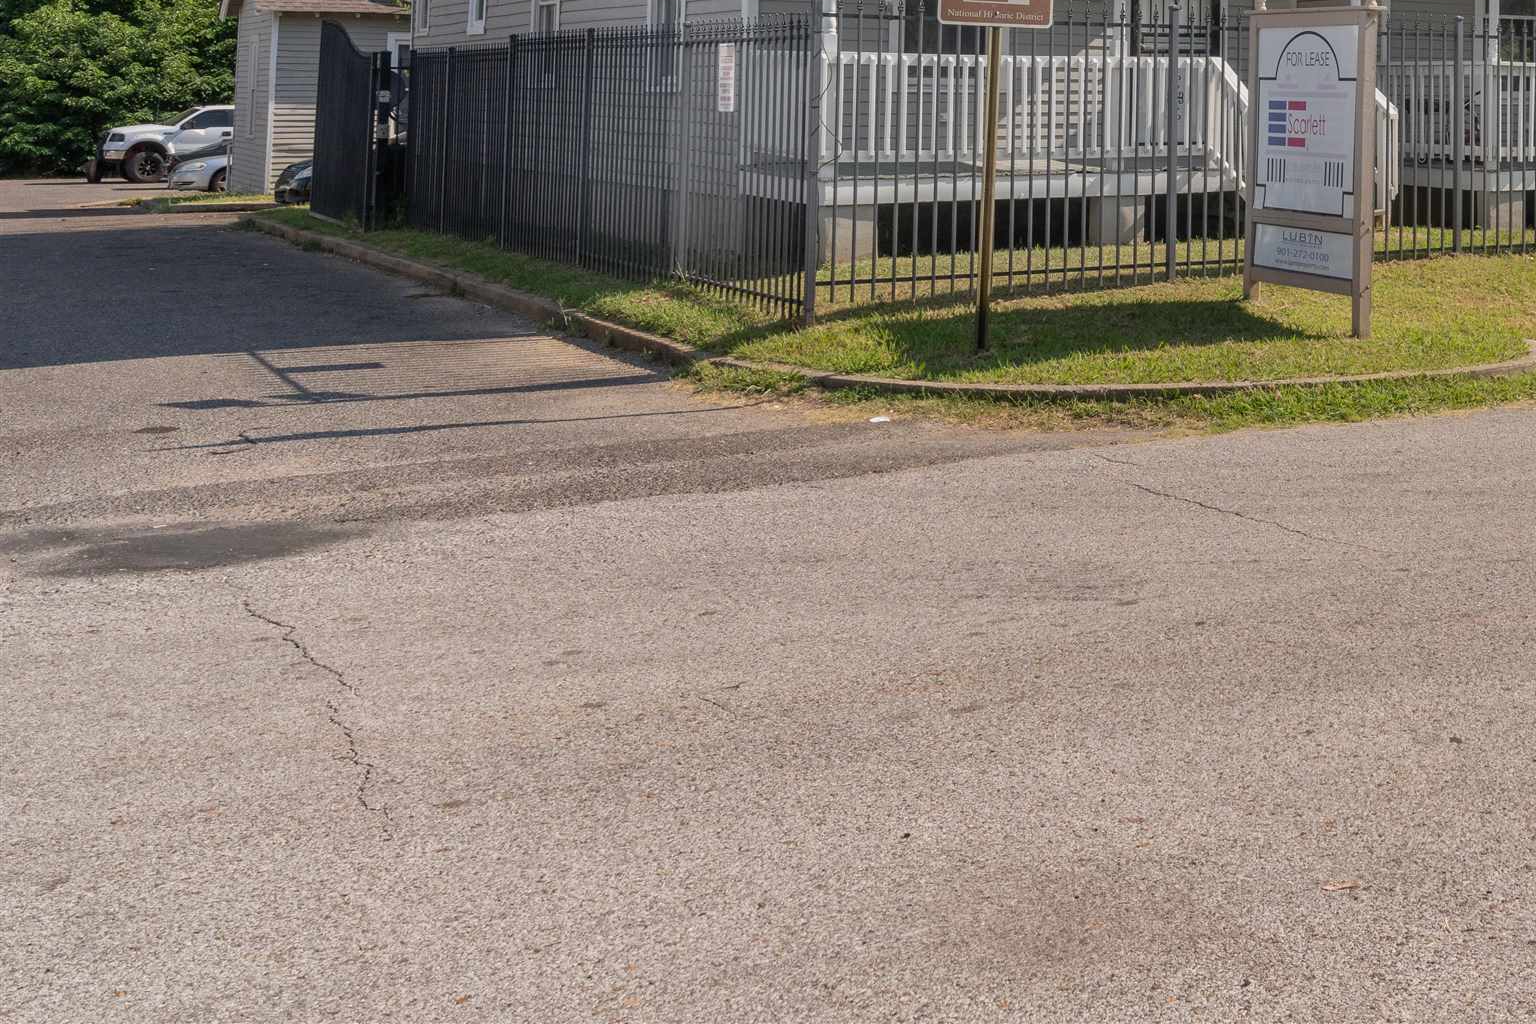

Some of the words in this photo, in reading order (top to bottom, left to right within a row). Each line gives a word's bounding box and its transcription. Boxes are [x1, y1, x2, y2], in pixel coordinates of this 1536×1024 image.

[947, 8, 981, 18] National
[983, 10, 1014, 19] Hioric
[1016, 11, 1044, 22] District
[1286, 51, 1303, 67] FOR
[1304, 51, 1330, 67] LEASE
[1287, 113, 1326, 136] Scarlett
